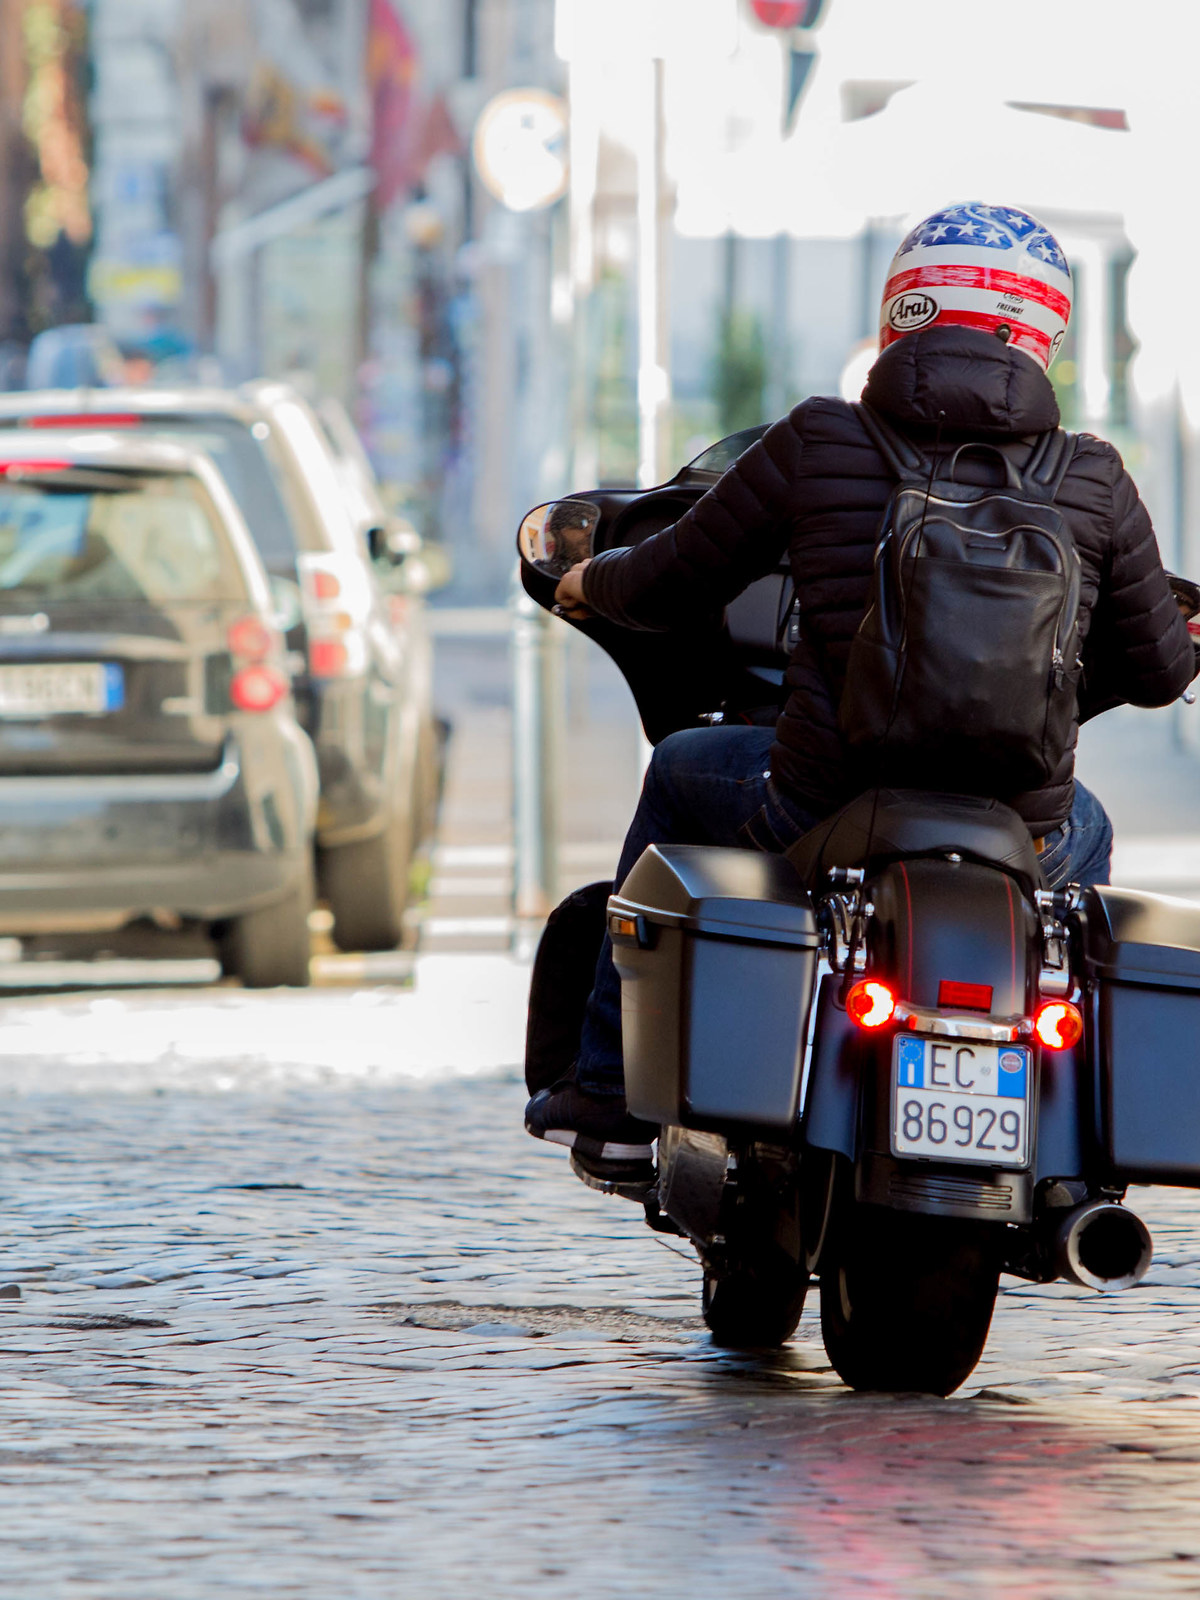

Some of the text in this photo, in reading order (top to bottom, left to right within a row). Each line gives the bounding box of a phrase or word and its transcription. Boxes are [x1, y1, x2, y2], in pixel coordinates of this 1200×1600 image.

[892, 296, 930, 321] Arai
[931, 1044, 976, 1088] EC
[902, 1100, 1020, 1152] 86929
